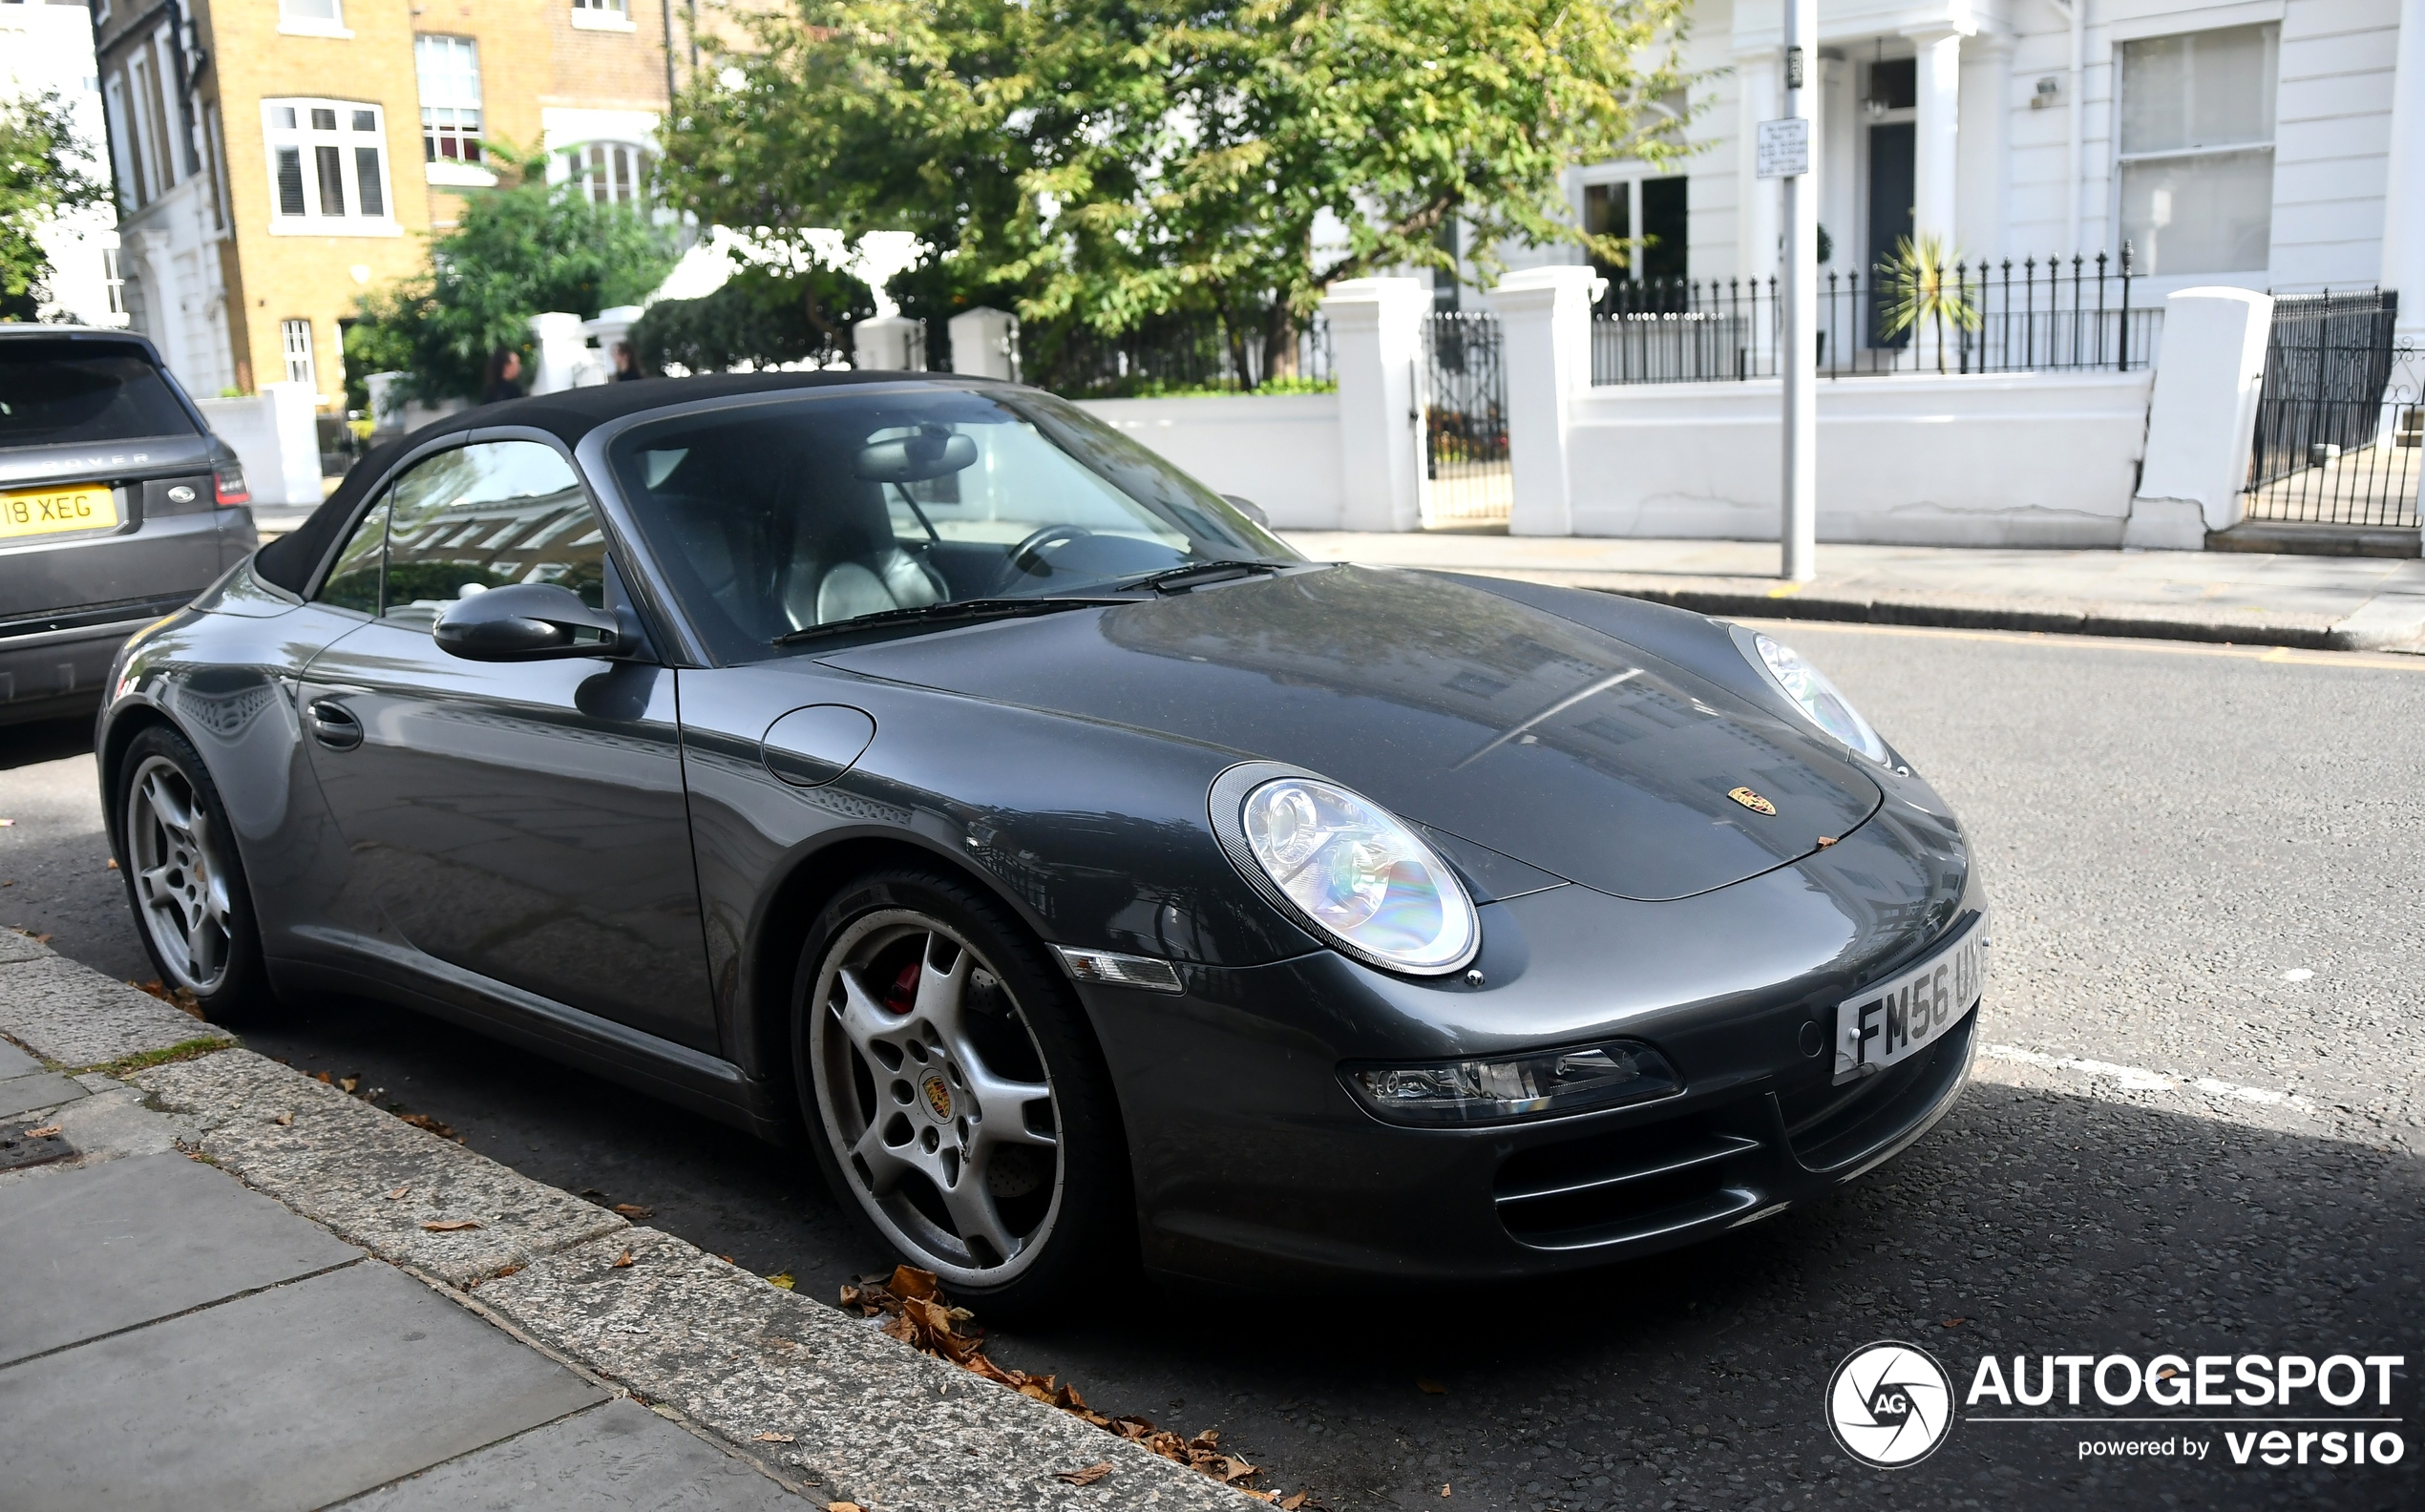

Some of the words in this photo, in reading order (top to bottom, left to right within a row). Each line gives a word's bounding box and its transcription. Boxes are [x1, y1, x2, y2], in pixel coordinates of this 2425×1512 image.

[40, 452, 149, 471] ROVER
[38, 495, 91, 521] XEG
[1857, 963, 1949, 1064] FM56
